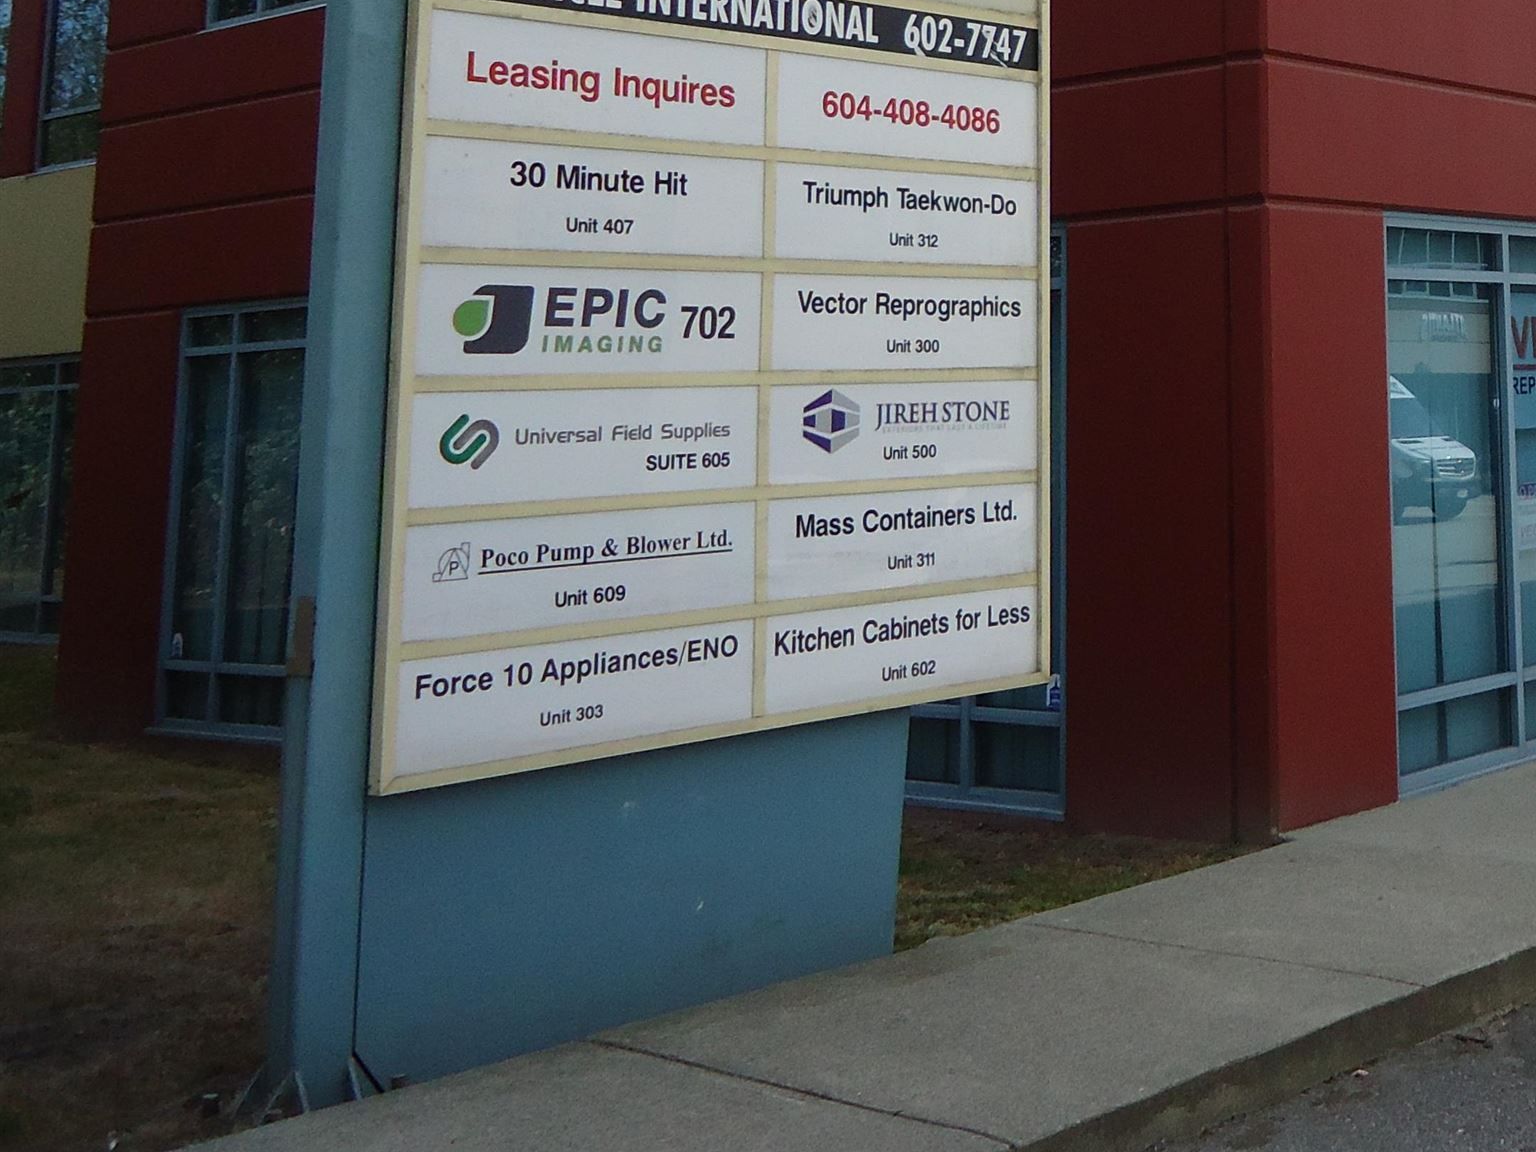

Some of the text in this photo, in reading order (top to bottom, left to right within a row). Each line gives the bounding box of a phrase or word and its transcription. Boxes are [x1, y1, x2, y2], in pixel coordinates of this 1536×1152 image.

[466, 50, 735, 109] Leasing Inquires
[822, 90, 1001, 134] 604-408-4086
[510, 160, 688, 196] 30 Minute Hit
[803, 181, 1017, 216] Triumph Taekwon-Do
[566, 217, 634, 235] Unit 407
[889, 232, 939, 248] Unit 312
[543, 286, 736, 340] EPIC 702
[798, 290, 1022, 322] Vector Reprographics
[541, 334, 663, 353] IMAGING
[886, 339, 940, 354] Unit 300
[875, 400, 1010, 432] JIREH STONE
[515, 422, 731, 446] Universal Field Supplies
[645, 451, 731, 472] SUITE 605
[883, 444, 937, 461] Unit 500
[795, 499, 1018, 539] Mass Containers Ltd.
[480, 529, 734, 569] Poco Pump & Blower Ltd.
[888, 552, 936, 570] Unit 311
[554, 584, 627, 608] Unit 609
[774, 604, 1031, 656] Kitchen Cabinets for Less
[414, 633, 739, 700] Force 10 Appliances/ENO
[881, 659, 936, 682] Unit 602
[539, 704, 604, 728] Unit 303
